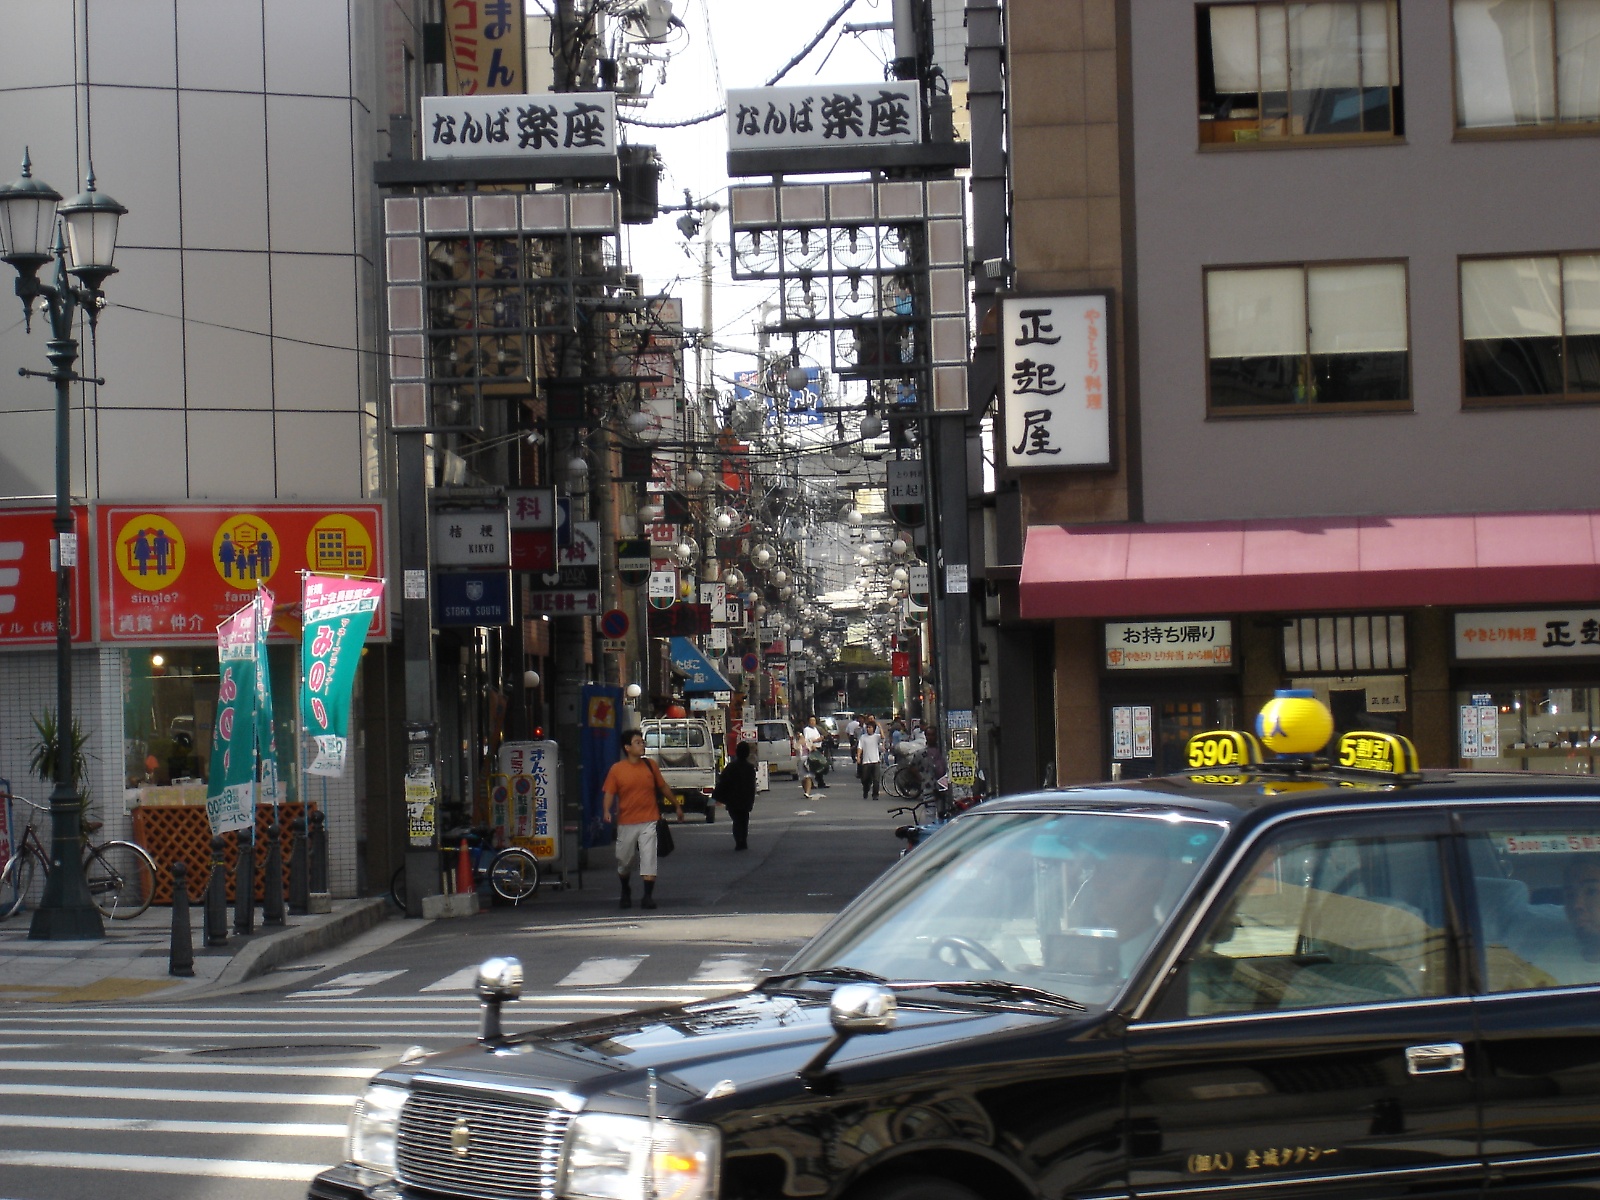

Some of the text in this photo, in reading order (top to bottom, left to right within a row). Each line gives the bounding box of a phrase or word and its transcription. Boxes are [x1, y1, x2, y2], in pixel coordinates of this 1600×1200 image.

[736, 90, 911, 139] なんば楽座
[432, 102, 606, 149] なんば楽座
[1012, 309, 1066, 455] 正起屋
[891, 484, 924, 497] 正起
[469, 544, 494, 553] KIKYO
[131, 592, 179, 604] single?
[446, 606, 501, 616] STORK SOUTH
[1123, 626, 1215, 644] お持ち帰り
[1464, 628, 1537, 643] やきとり料理
[309, 625, 334, 729] みのり
[1340, 738, 1390, 767] 5割引
